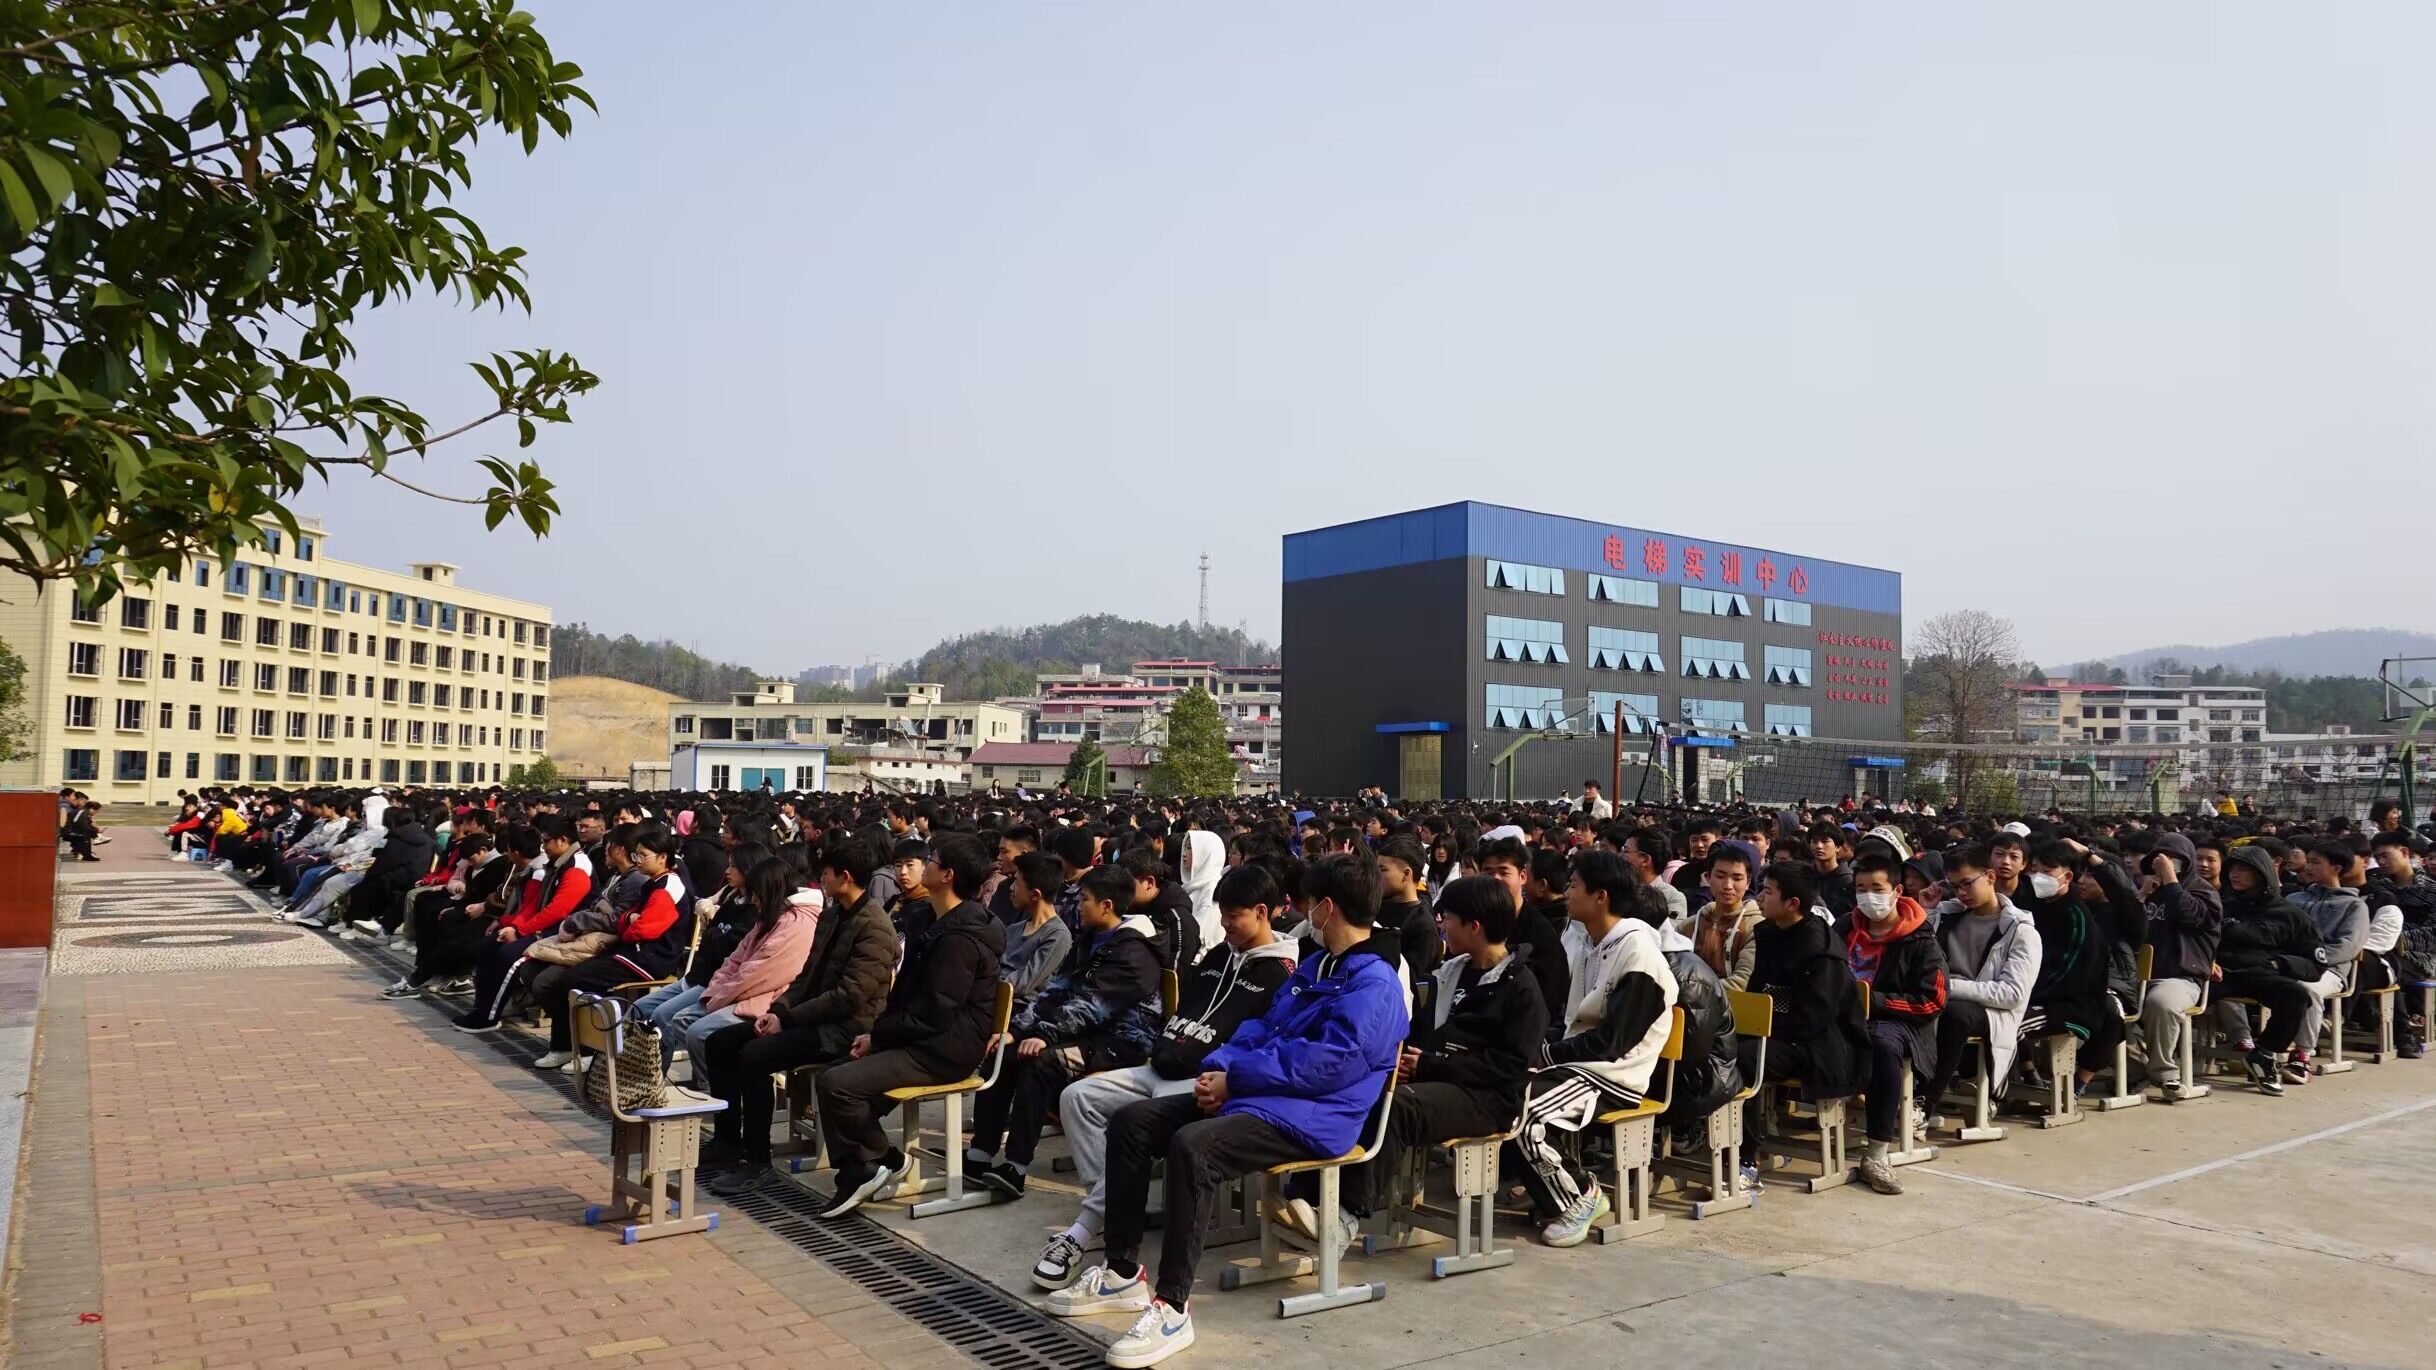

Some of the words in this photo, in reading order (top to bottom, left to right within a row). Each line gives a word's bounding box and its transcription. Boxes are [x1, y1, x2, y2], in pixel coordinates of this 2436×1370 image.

[1603, 533, 1808, 594] 电梯实训中心
